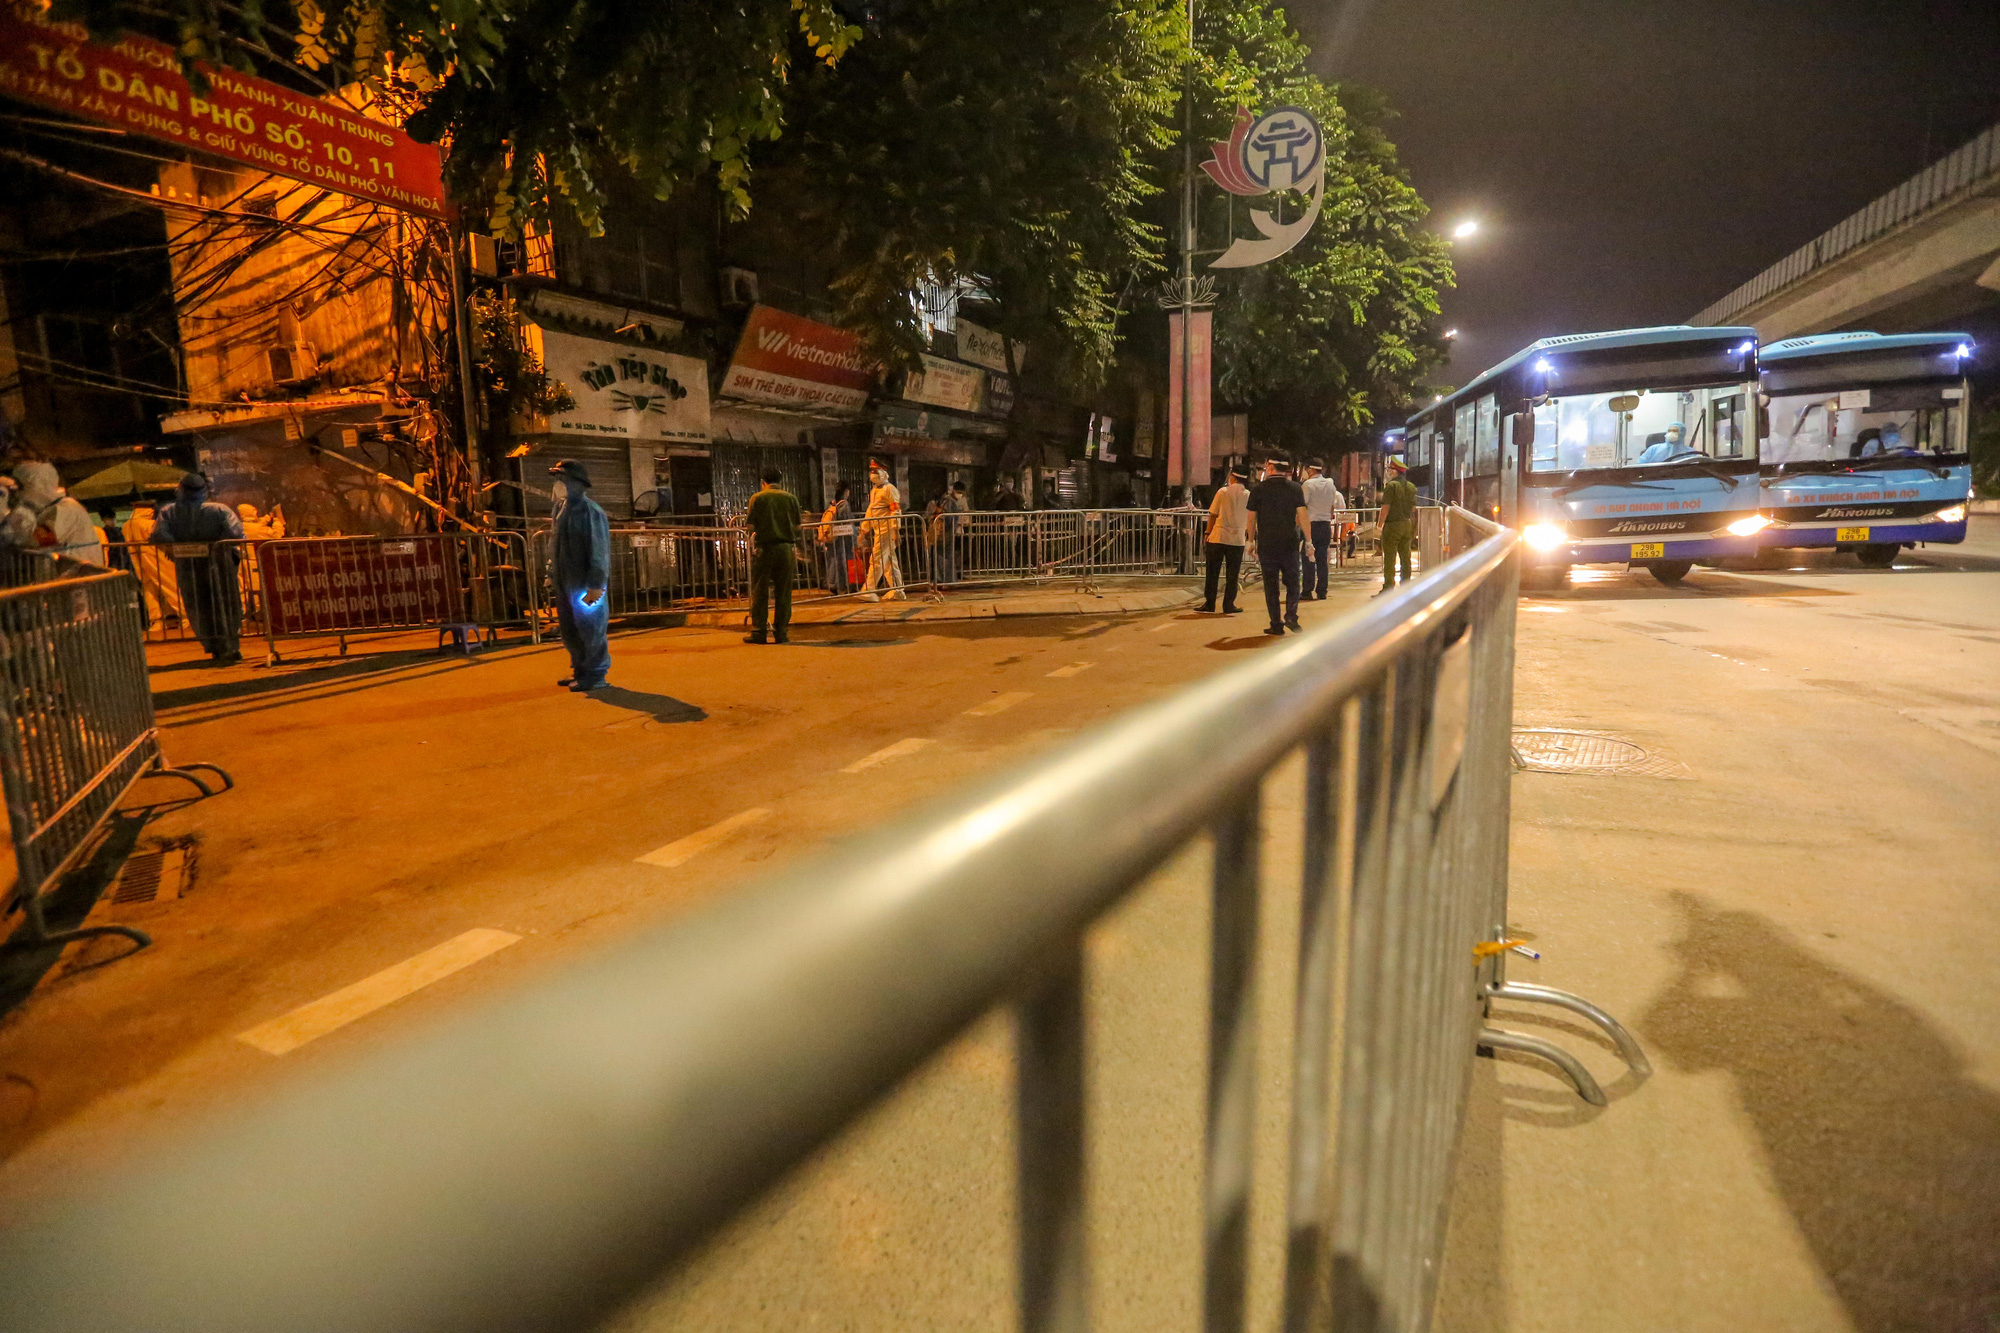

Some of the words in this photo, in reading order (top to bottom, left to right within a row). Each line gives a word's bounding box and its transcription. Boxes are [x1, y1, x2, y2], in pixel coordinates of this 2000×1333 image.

[29, 44, 85, 80] TỔ
[99, 67, 179, 112] DÂN
[190, 97, 255, 135] PHỐ
[265, 123, 312, 153] SỐ:
[323, 143, 360, 171] 10,
[369, 157, 394, 179] 11
[208, 72, 276, 107] THANH
[283, 99, 334, 127] XUÂN
[339, 118, 394, 147] TRUNG
[127, 108, 183, 136] DỰNG
[188, 126, 200, 141] &
[205, 132, 236, 151] GIỮ
[240, 141, 287, 167] VỮNG
[291, 155, 312, 174] TỔ
[315, 165, 346, 186] DÂN
[350, 174, 379, 195] PHỐ
[381, 184, 410, 204] VĂN
[413, 195, 441, 213] HOÁ
[734, 374, 754, 389] SIM
[1608, 521, 1687, 532] HANOIBUS
[1816, 508, 1894, 518] HANOIBUS
